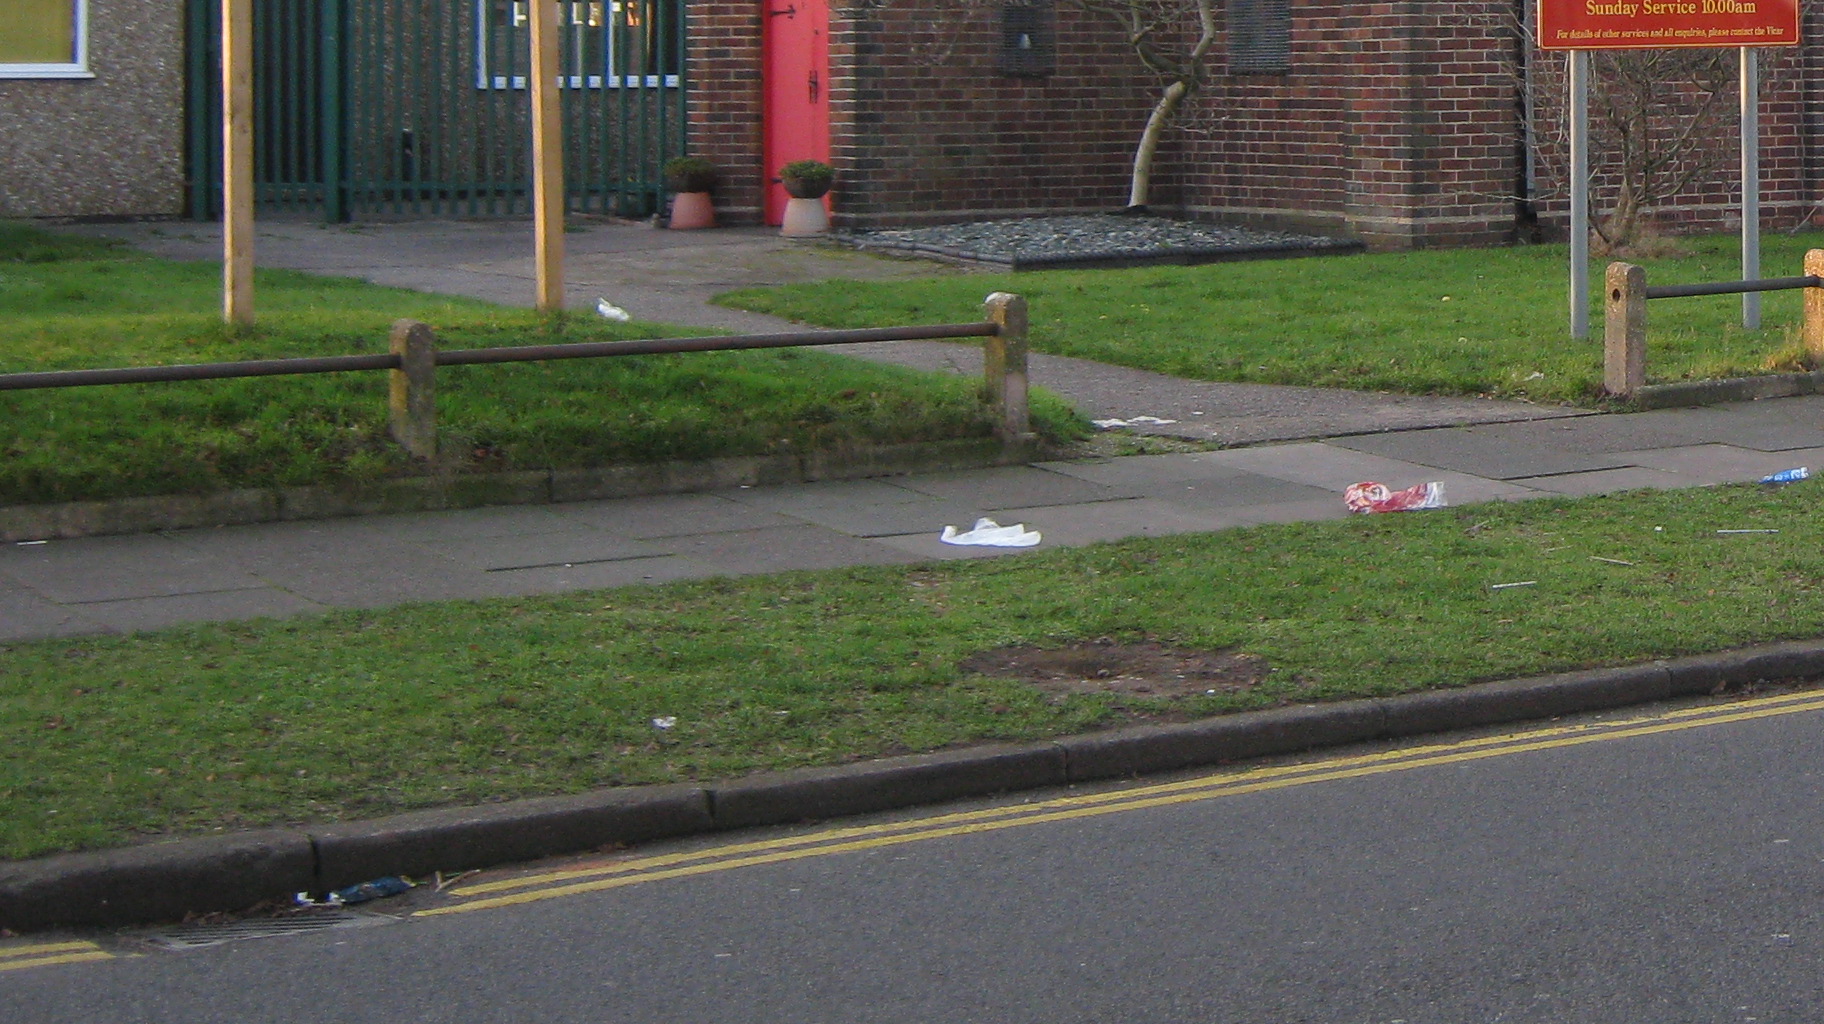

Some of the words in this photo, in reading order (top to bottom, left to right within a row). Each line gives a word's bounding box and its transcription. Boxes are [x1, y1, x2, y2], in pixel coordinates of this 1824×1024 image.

[1586, 0, 1639, 18] Sunday
[1557, 29, 1568, 39] For
[1569, 29, 1593, 39] details
[1594, 28, 1602, 38] of
[1602, 28, 1621, 38] other
[1621, 28, 1650, 38] services
[1650, 27, 1664, 37] and
[1664, 27, 1674, 37] all
[1708, 27, 1729, 38] please
[1730, 27, 1754, 36] contact
[1754, 26, 1765, 36] the
[1766, 25, 1784, 35] Vicar
